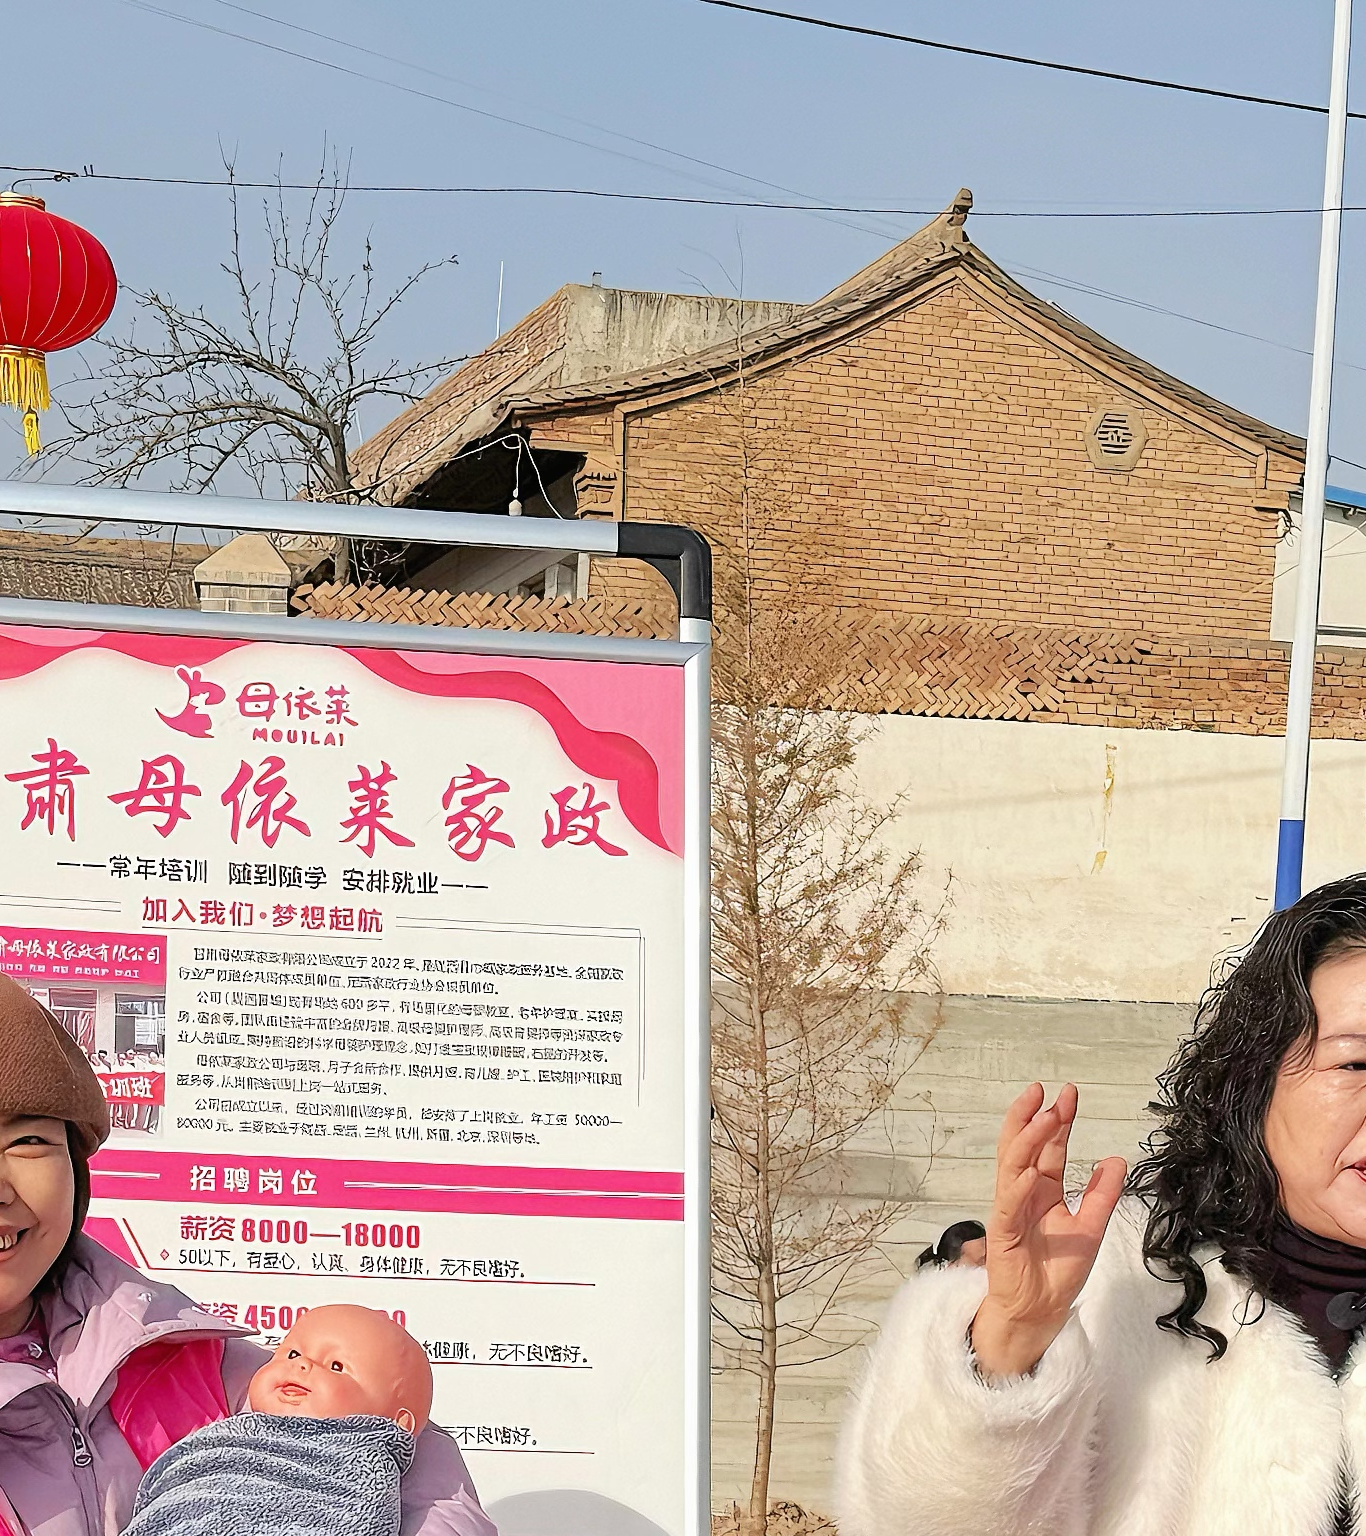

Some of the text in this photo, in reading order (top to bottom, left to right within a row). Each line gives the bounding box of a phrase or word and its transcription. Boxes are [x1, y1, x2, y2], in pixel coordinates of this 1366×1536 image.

[236, 682, 359, 728] 母依莱
[190, 1165, 321, 1197] 招聘岗位
[180, 1215, 421, 1249] 薪资 8000—18000
